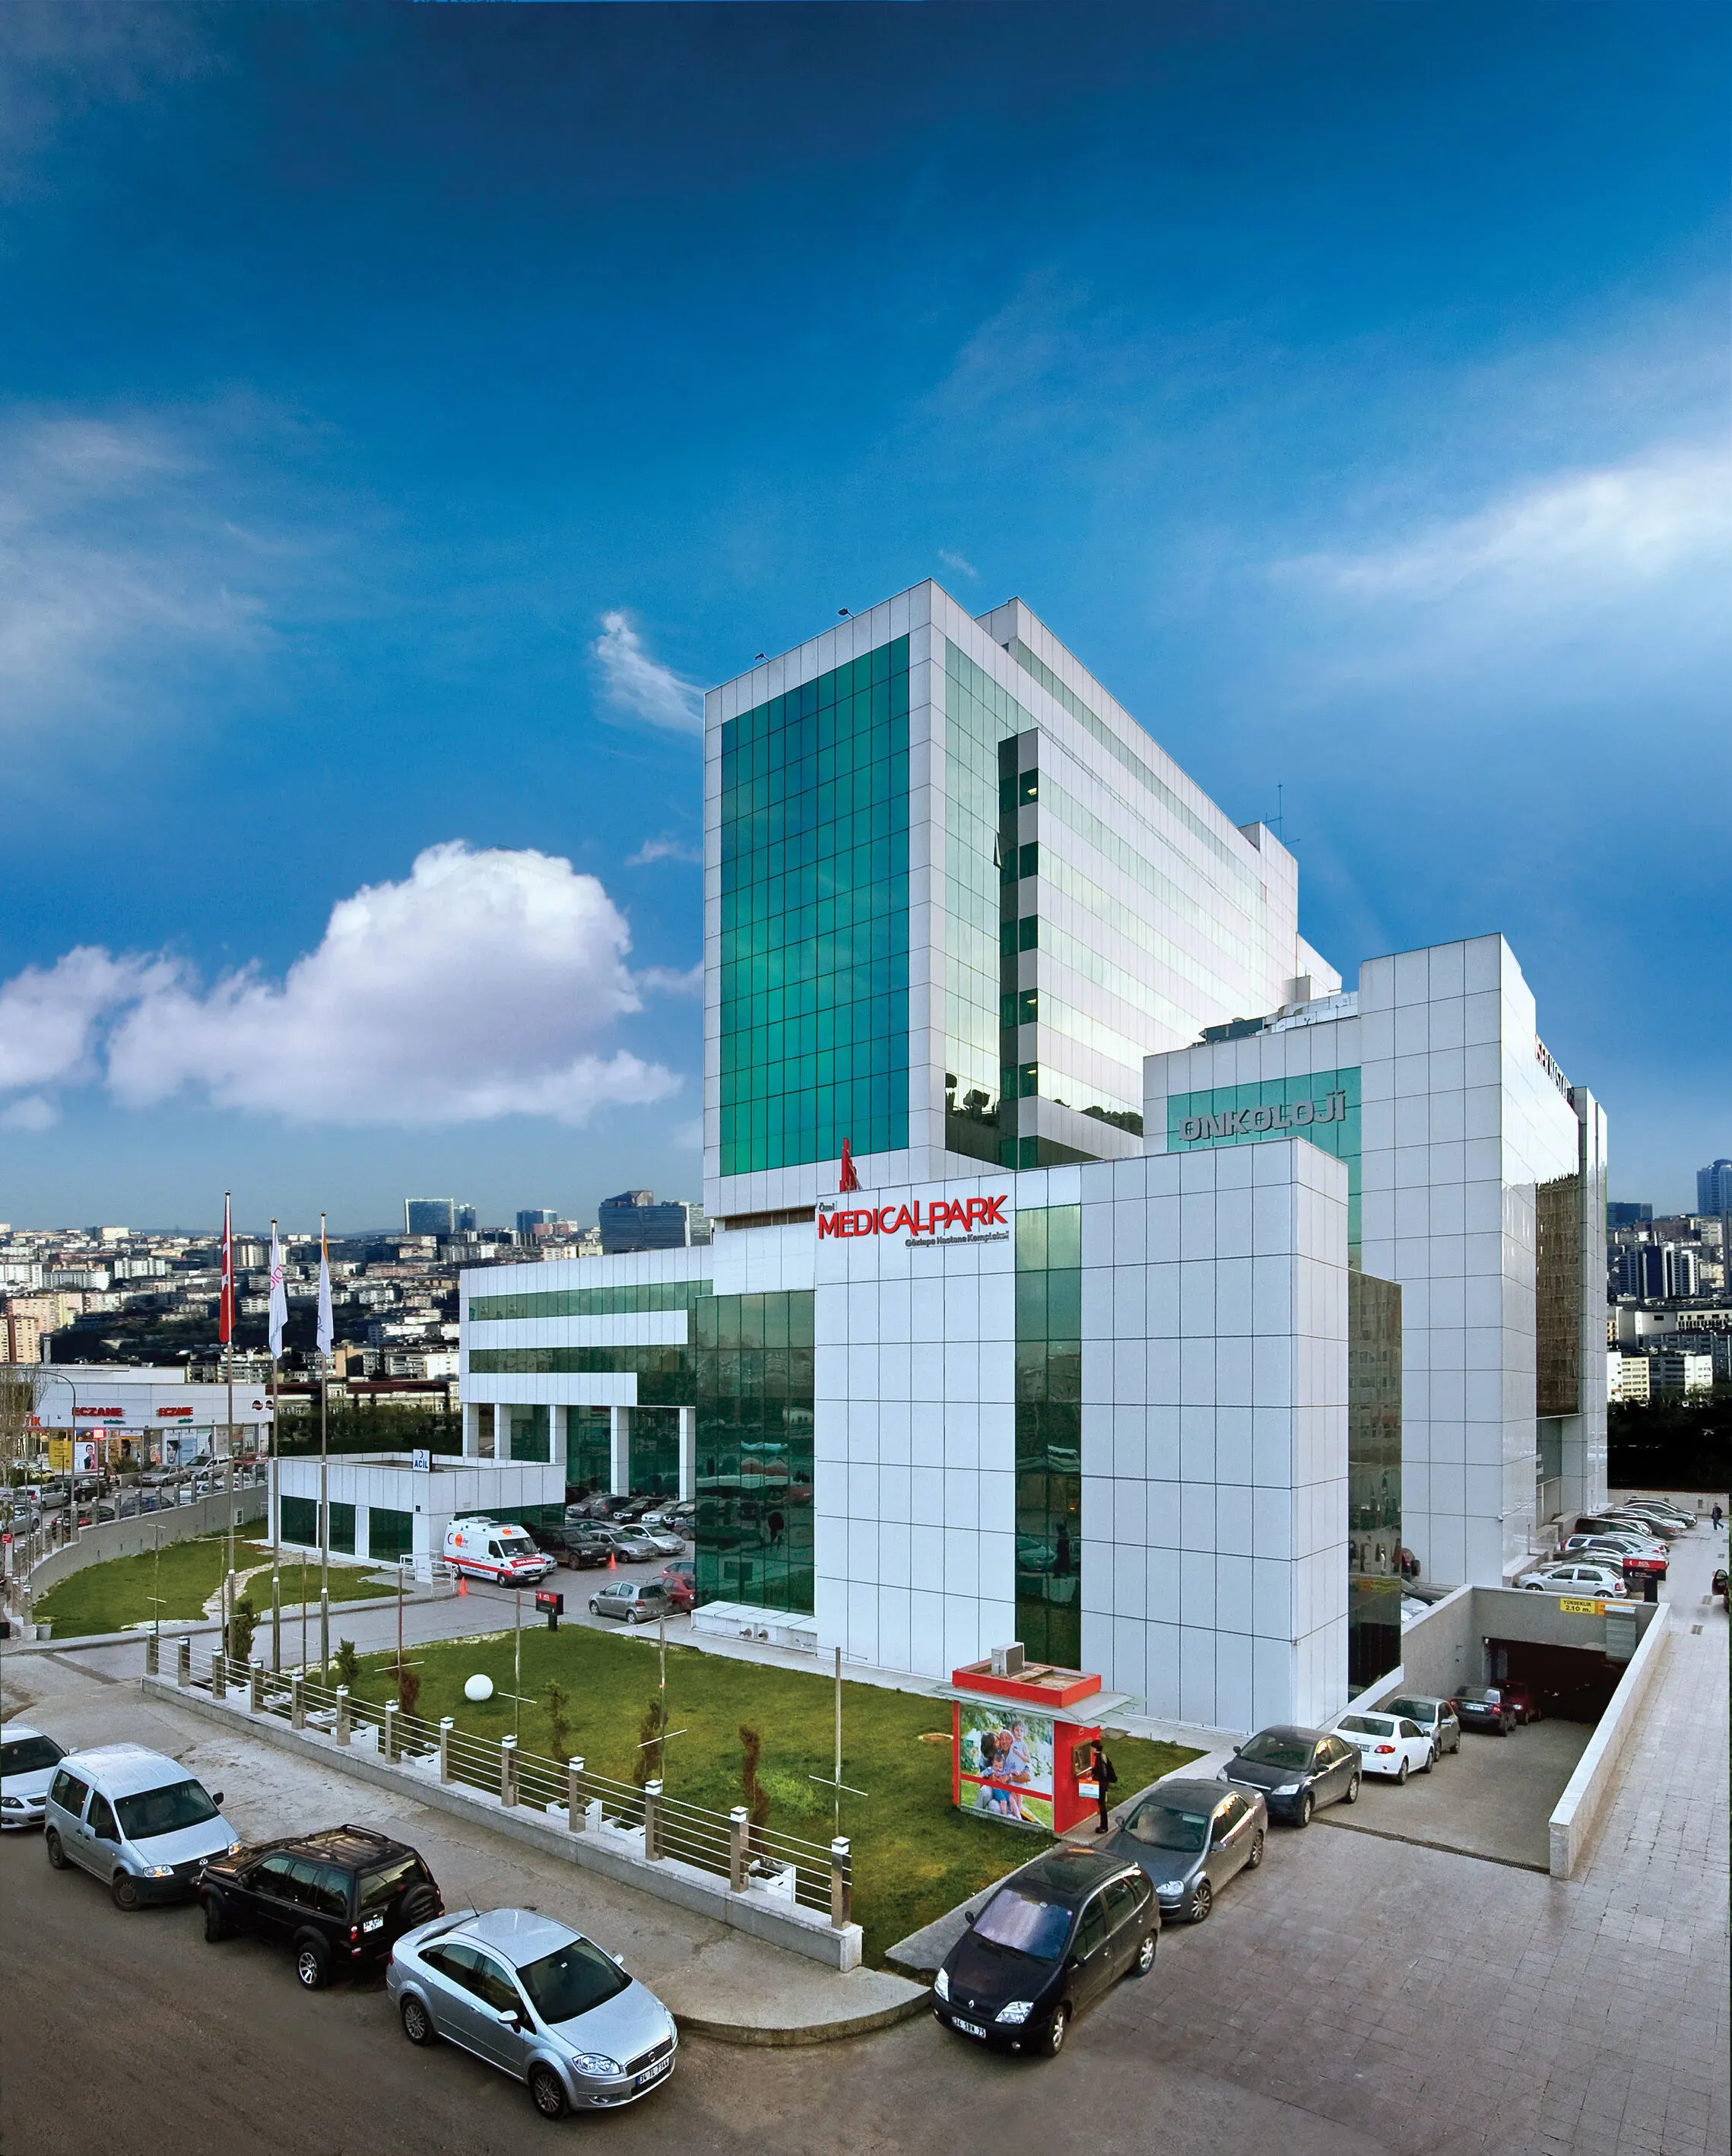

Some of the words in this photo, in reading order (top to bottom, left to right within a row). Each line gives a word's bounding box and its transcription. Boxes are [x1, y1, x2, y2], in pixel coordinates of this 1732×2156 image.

[1179, 1089, 1345, 1141] ONKOLOJİ
[937, 1236, 967, 1245] Hastane
[72, 1407, 123, 1417] ECZANE
